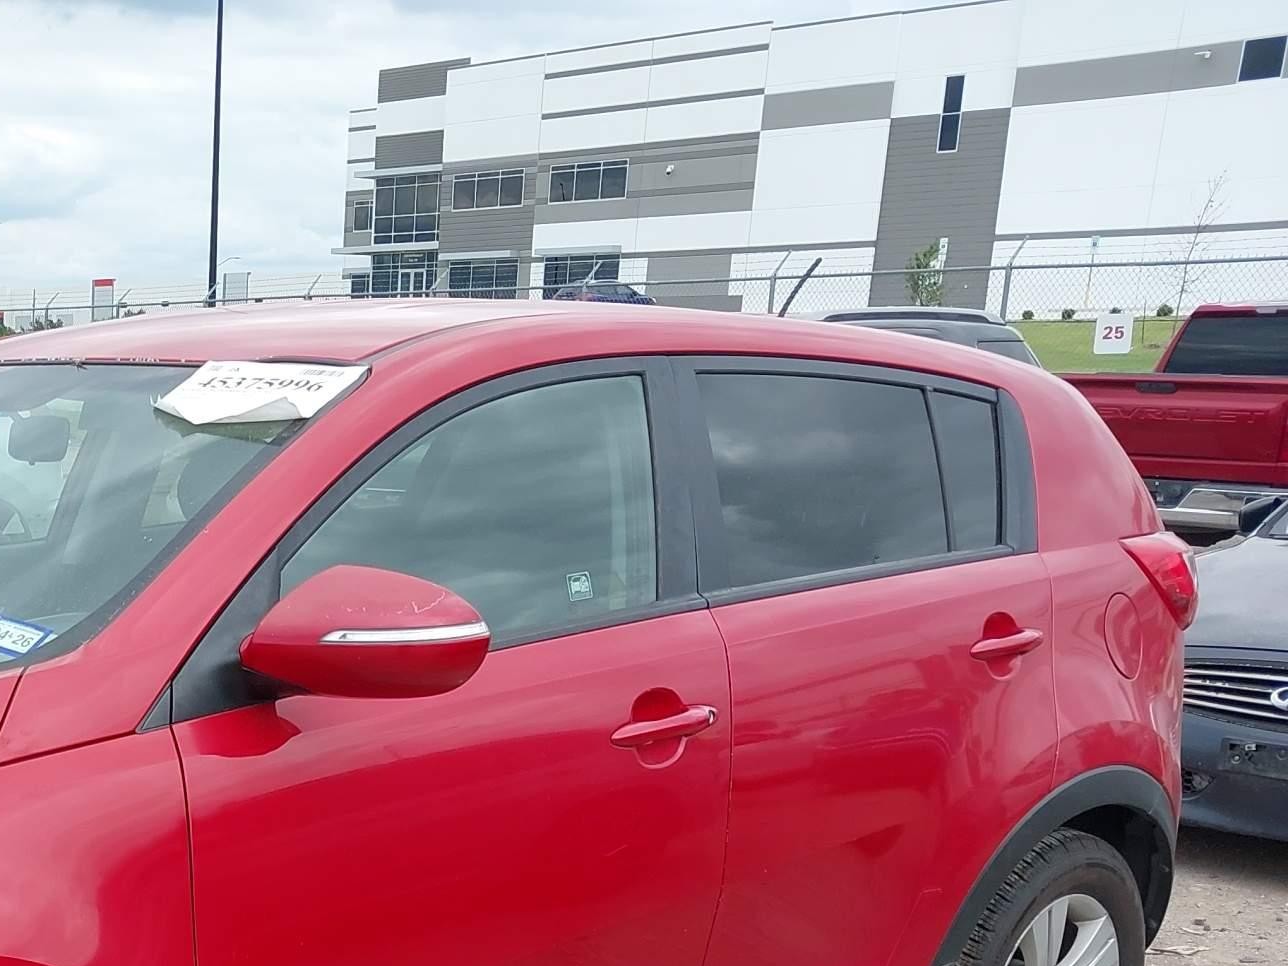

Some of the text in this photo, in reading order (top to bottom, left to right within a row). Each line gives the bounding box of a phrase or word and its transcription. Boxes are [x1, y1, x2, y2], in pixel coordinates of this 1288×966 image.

[1101, 325, 1126, 340] 25
[198, 375, 325, 393] 45375996
[1097, 406, 1266, 424] EVROLET
